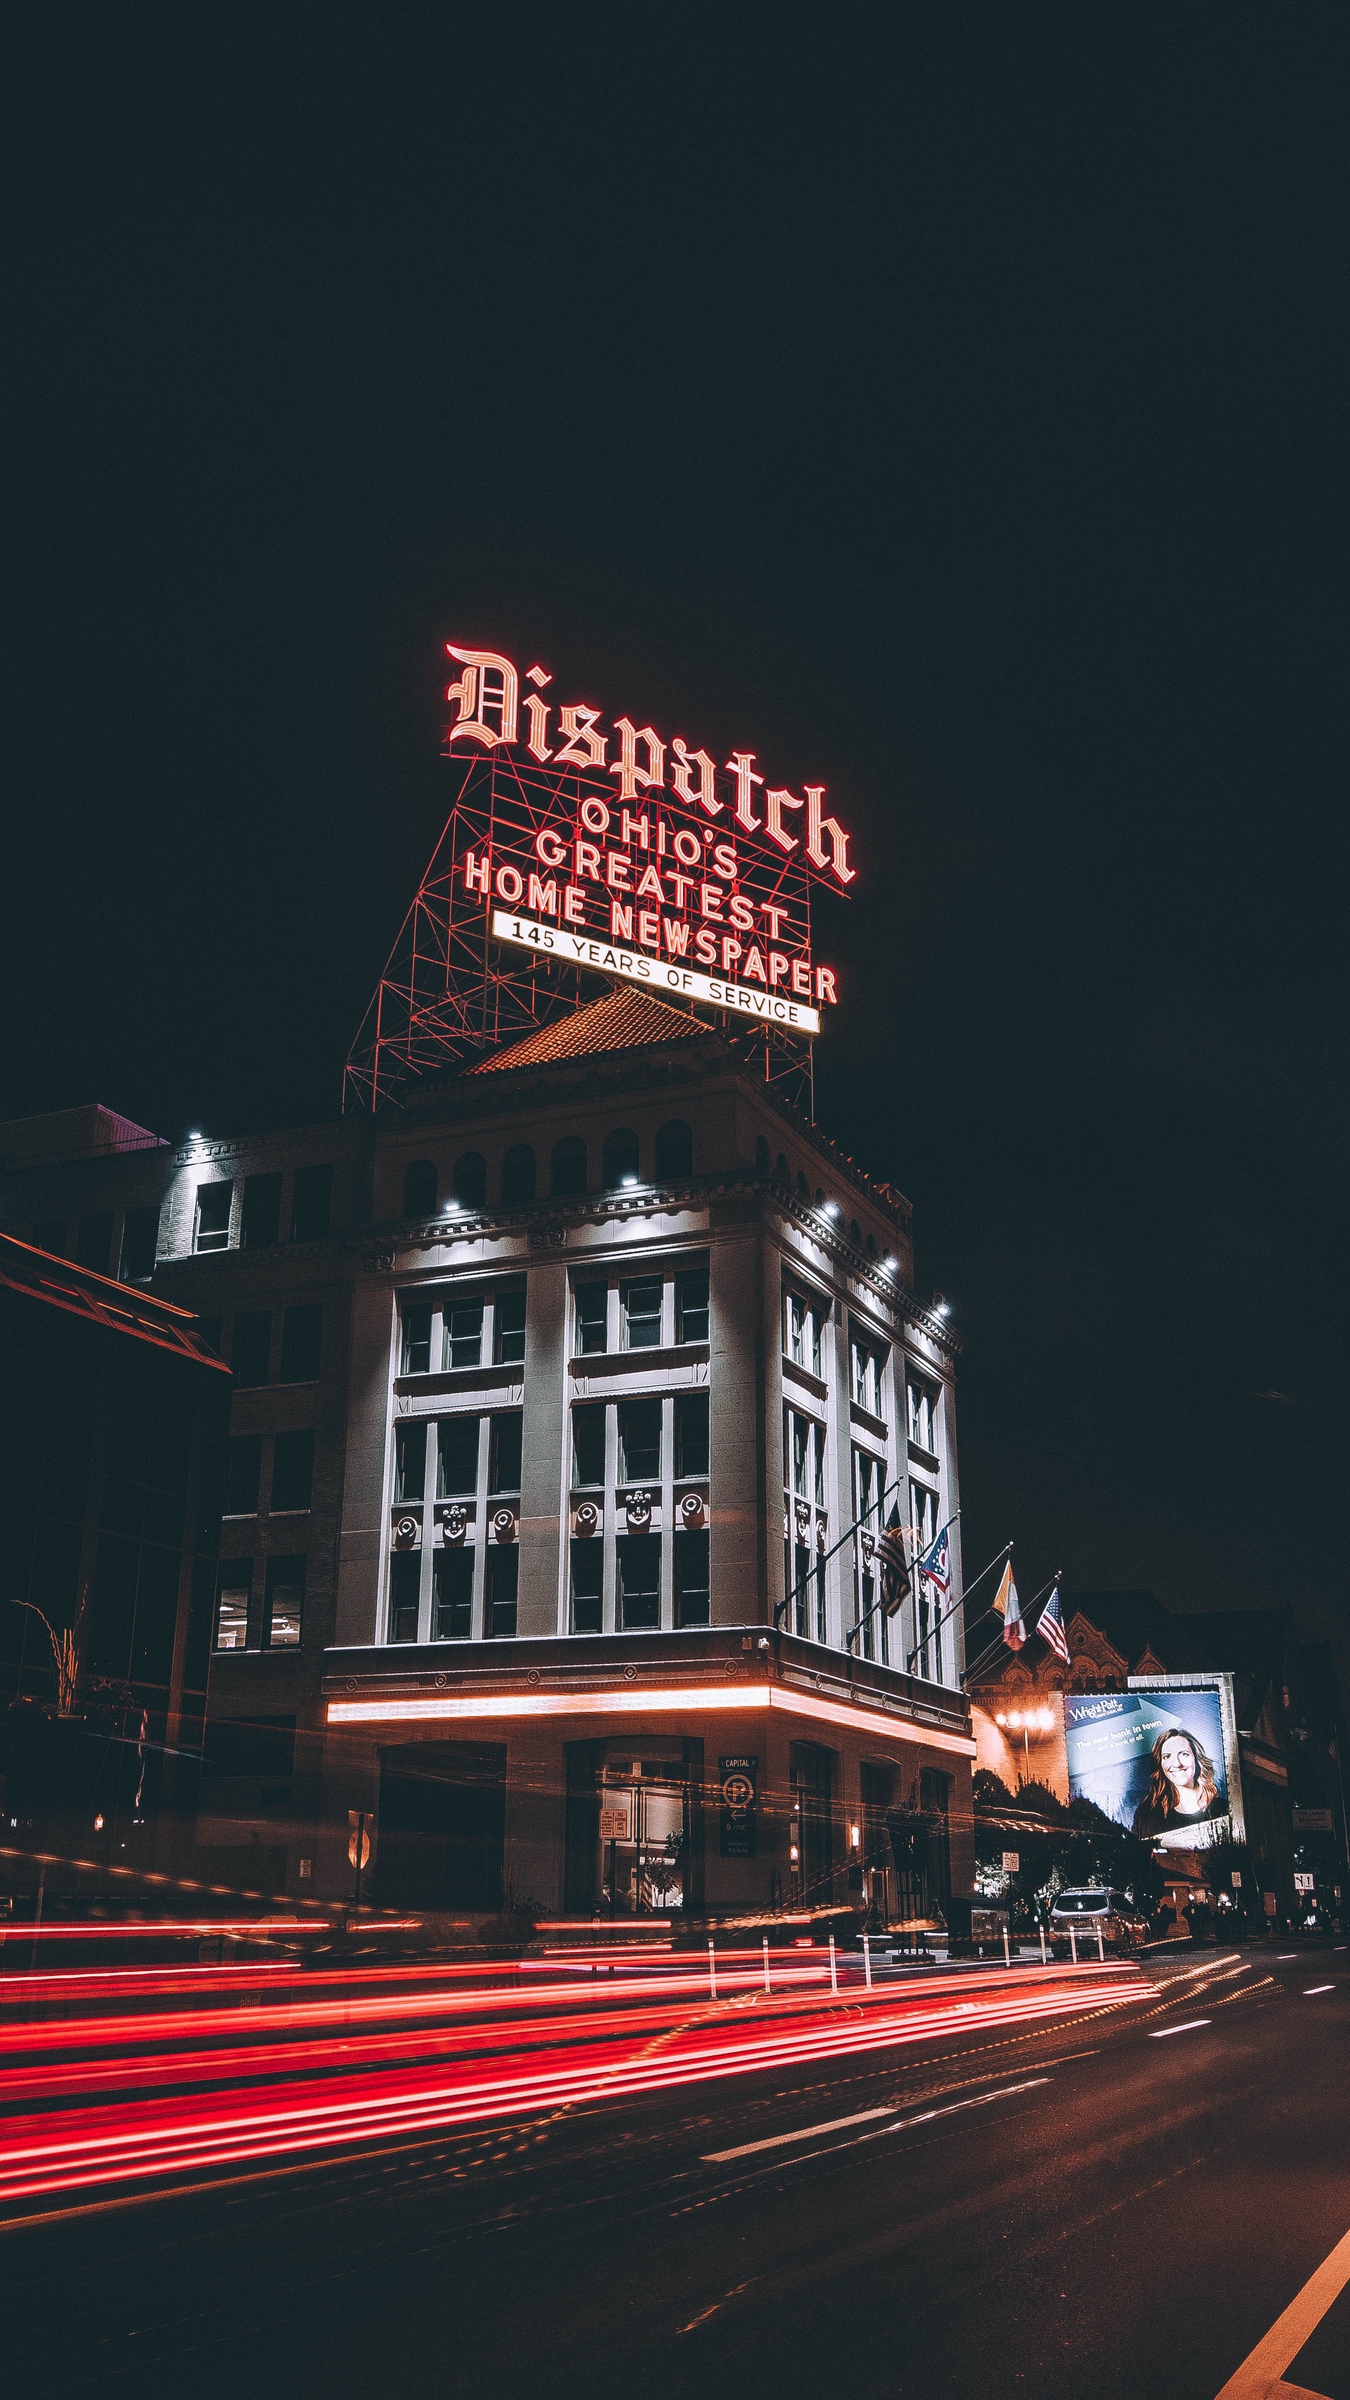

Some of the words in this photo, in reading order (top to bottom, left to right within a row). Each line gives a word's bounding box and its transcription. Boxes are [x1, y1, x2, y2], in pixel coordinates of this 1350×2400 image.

[446, 643, 856, 884] Dispatch
[535, 830, 789, 939] GREATEST
[580, 797, 739, 880] OHIO'S
[465, 851, 586, 925] HOME
[610, 901, 838, 1003] NEWSPAPER
[511, 921, 554, 948] 145
[571, 938, 651, 977] YEARS
[667, 969, 693, 989] OF
[709, 982, 799, 1023] SERVICE
[1076, 1741, 1091, 1750] The
[1094, 1736, 1108, 1745] new
[1110, 1728, 1131, 1739] bank
[1142, 1720, 1162, 1730] town
